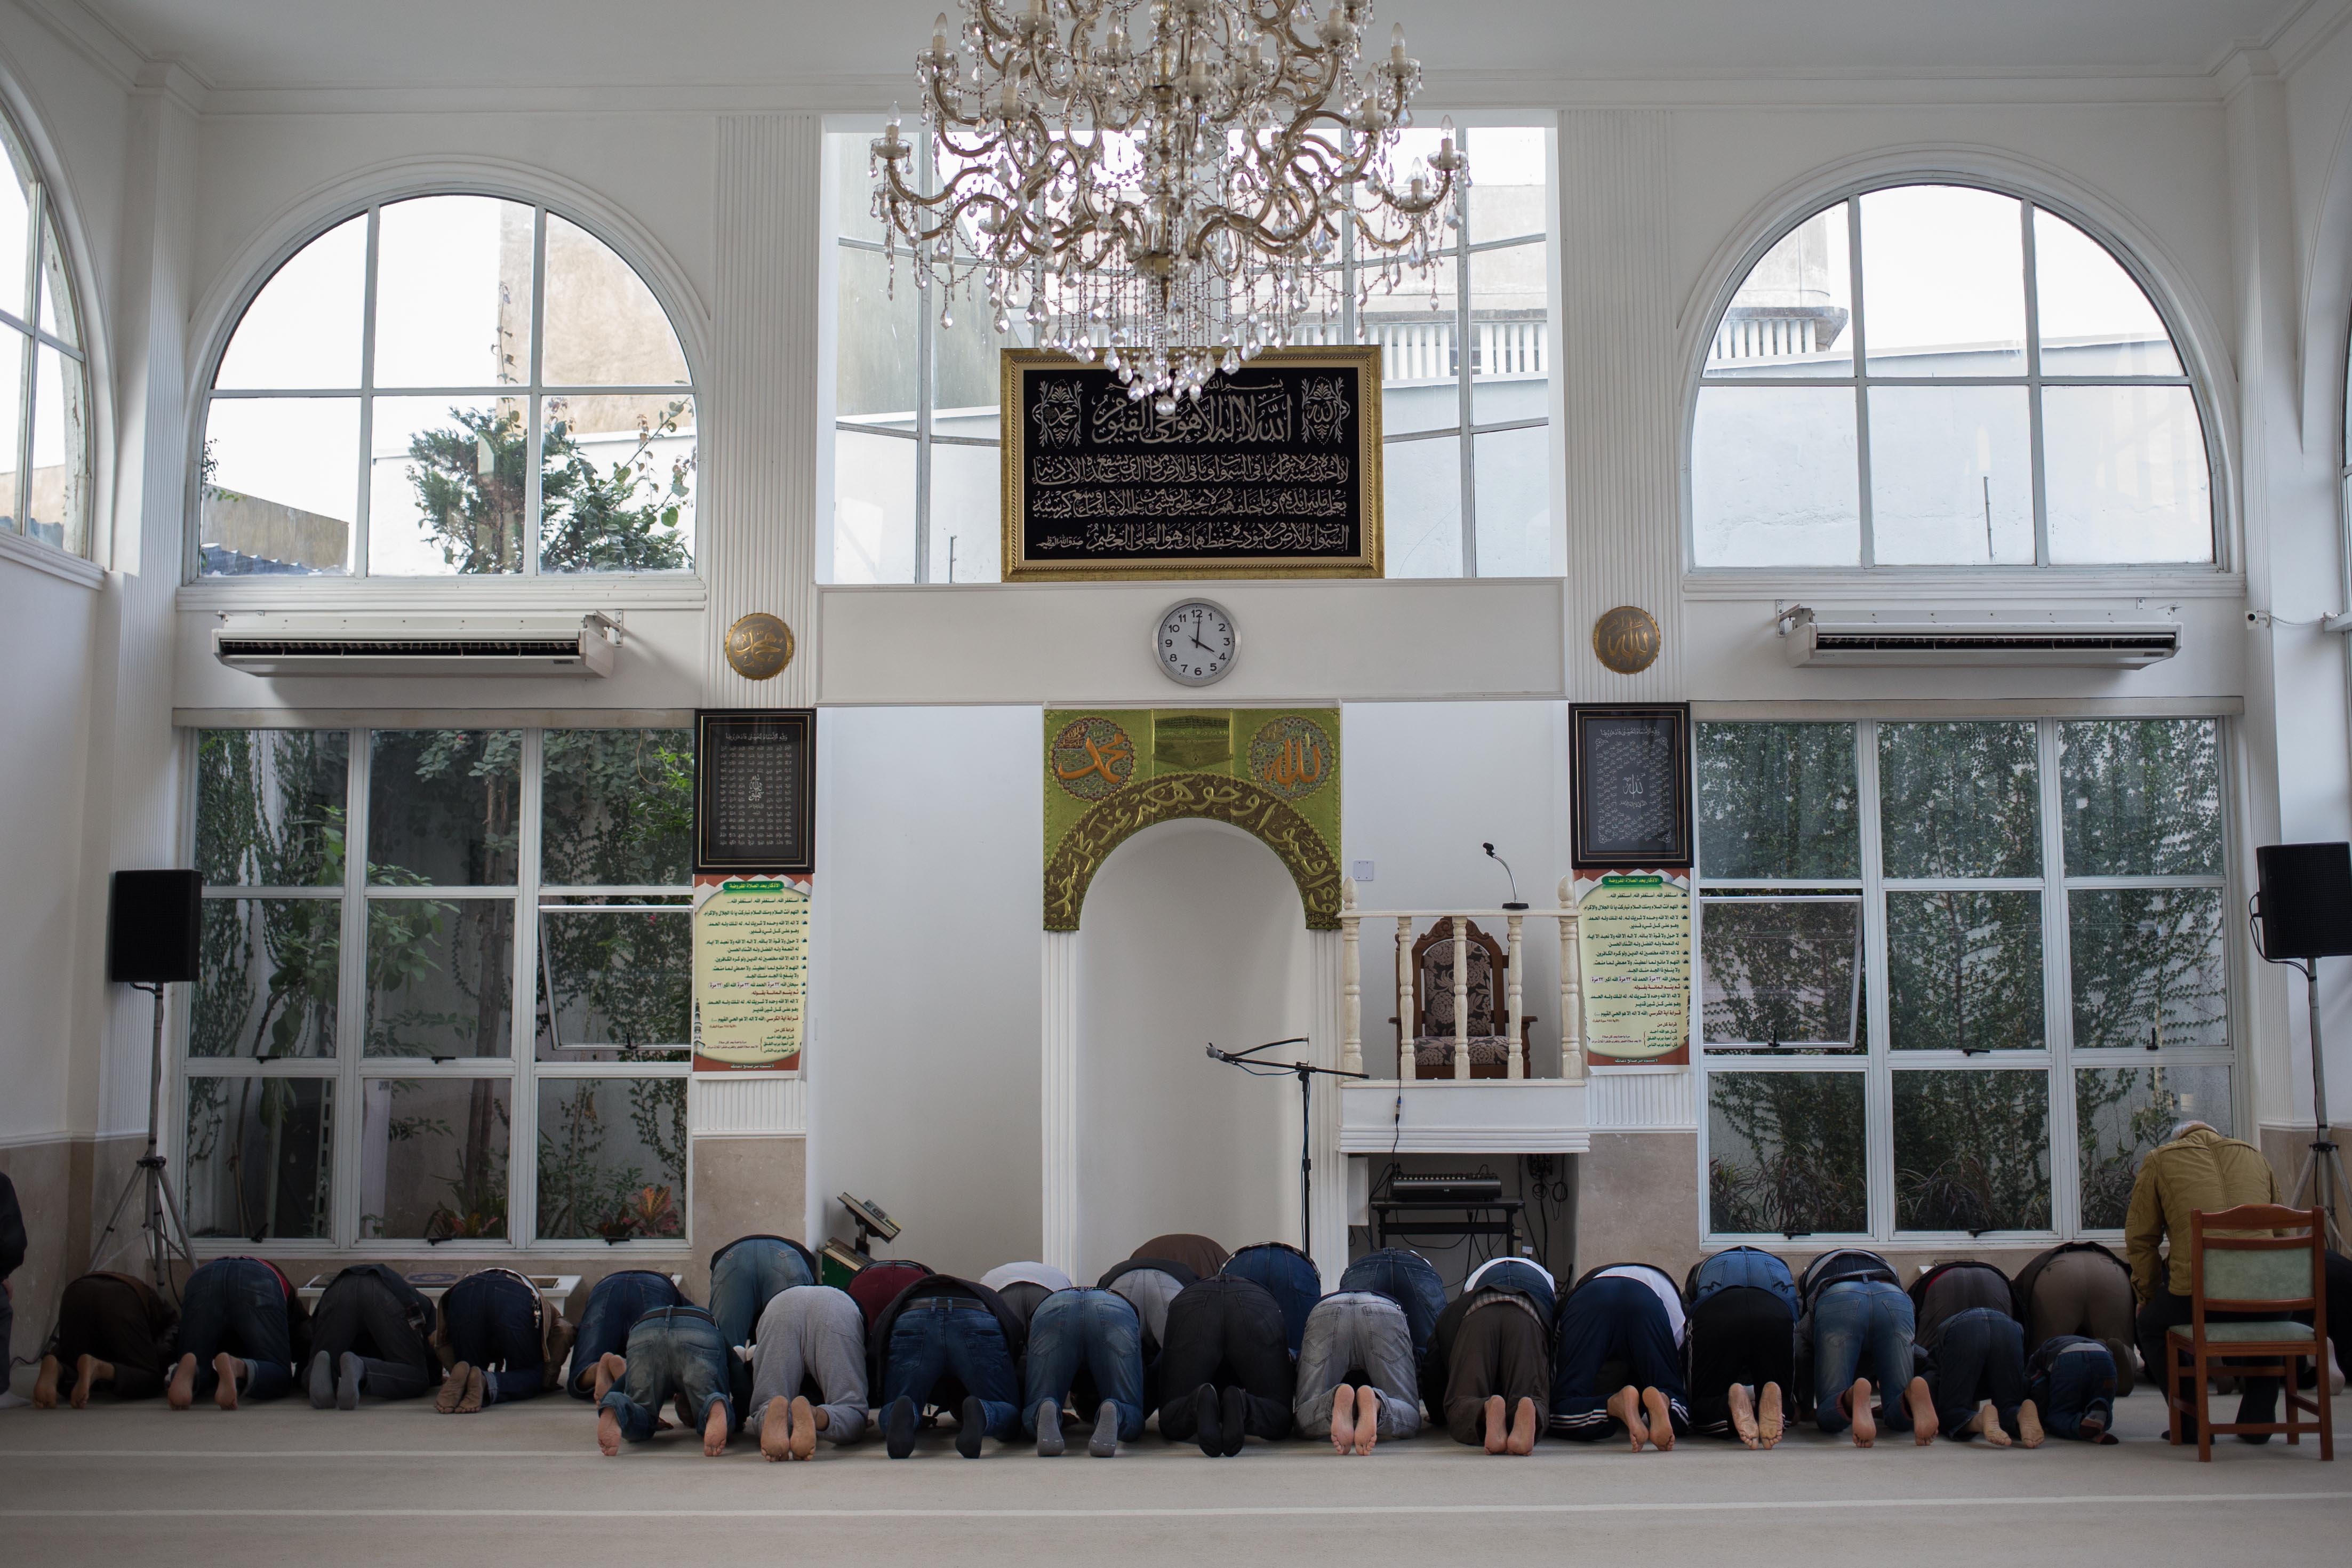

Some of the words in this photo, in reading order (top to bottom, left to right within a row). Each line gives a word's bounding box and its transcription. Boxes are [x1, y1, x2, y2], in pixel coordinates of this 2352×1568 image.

[1178, 614, 1186, 622] 11
[1191, 610, 1203, 618] 12
[1209, 613, 1212, 621] 1
[1169, 625, 1180, 633] 10
[1218, 623, 1226, 631] 2
[1165, 639, 1173, 647] 9
[1223, 638, 1230, 646] 3
[1170, 654, 1177, 662] 8
[1219, 652, 1226, 661] 4
[1181, 665, 1188, 673] 7
[1210, 663, 1217, 671] 5
[1194, 667, 1202, 676] 6
